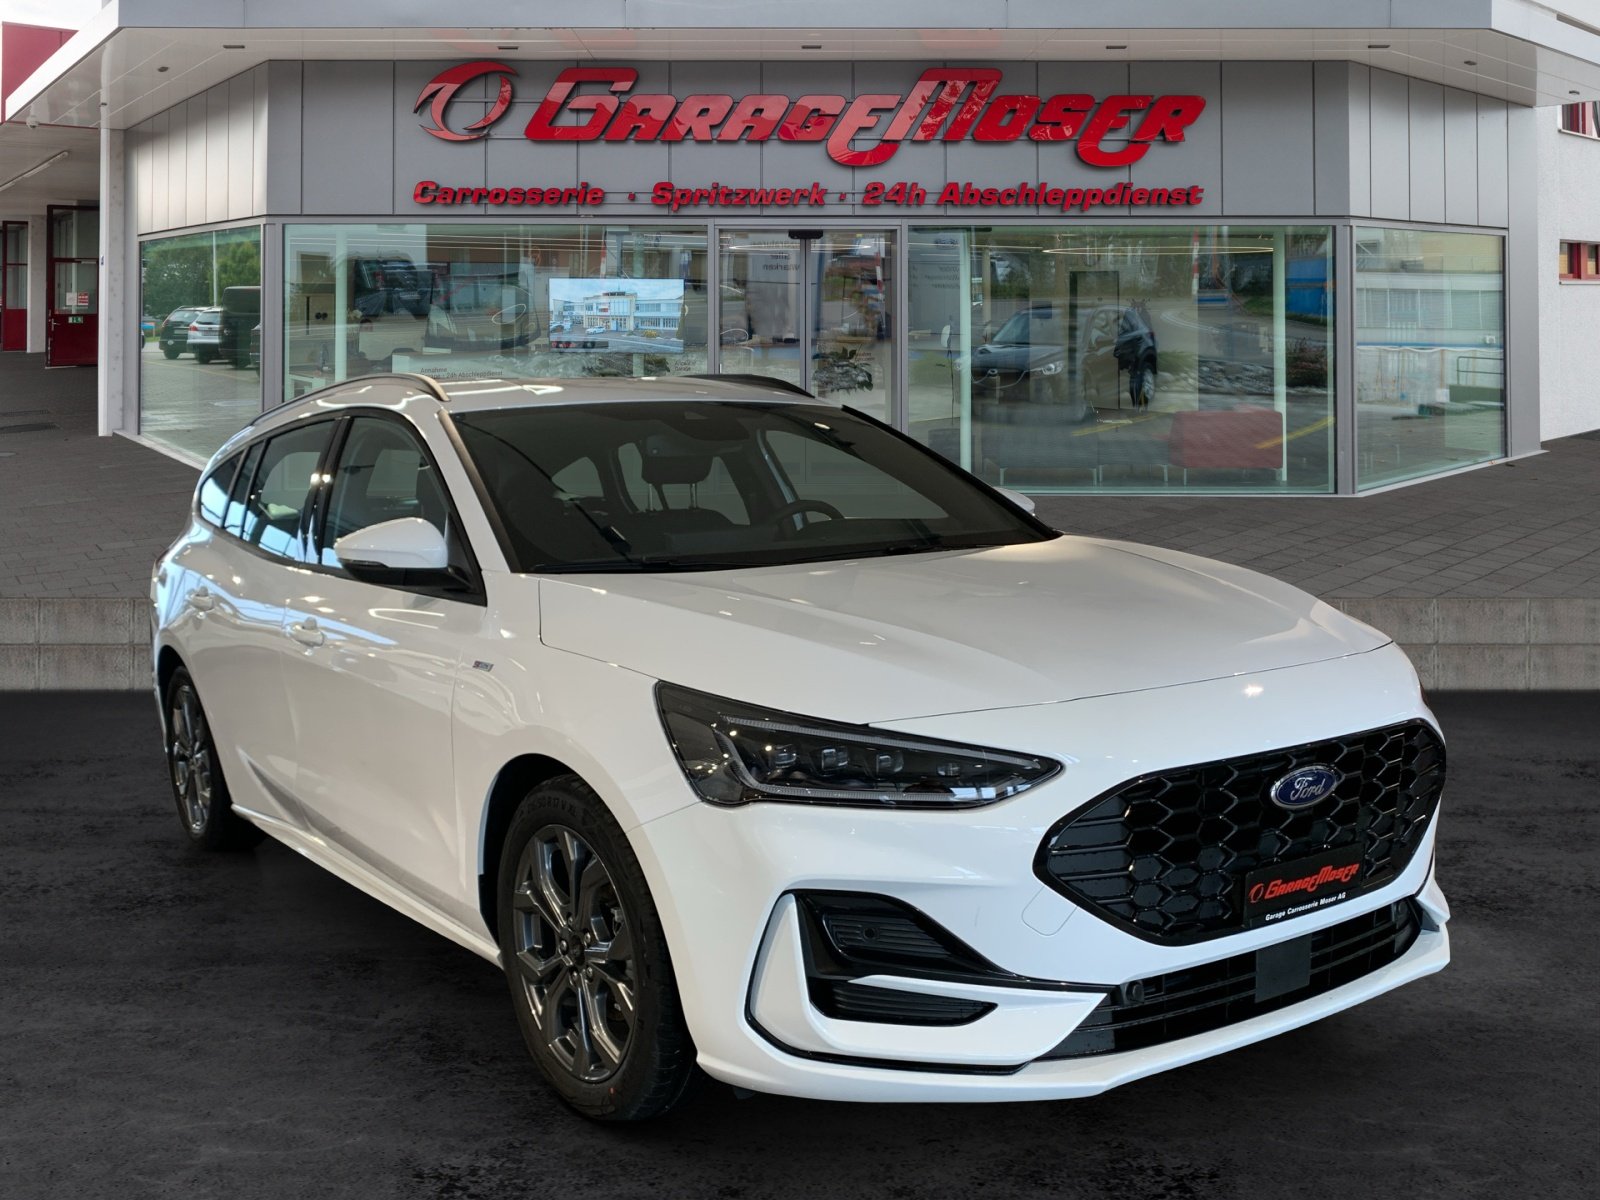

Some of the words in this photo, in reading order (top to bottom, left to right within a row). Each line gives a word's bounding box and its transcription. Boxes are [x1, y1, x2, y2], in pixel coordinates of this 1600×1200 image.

[413, 180, 605, 206] Carrosserie
[651, 181, 825, 212] Spritzwerk
[862, 182, 926, 206] 24h
[936, 182, 1204, 212] Abschleppdienst
[1290, 777, 1325, 800] Ford
[1265, 911, 1286, 921] Garage
[1287, 900, 1318, 914] Carrosserie
[1319, 896, 1337, 905] Moser
[1337, 891, 1346, 901] AG
